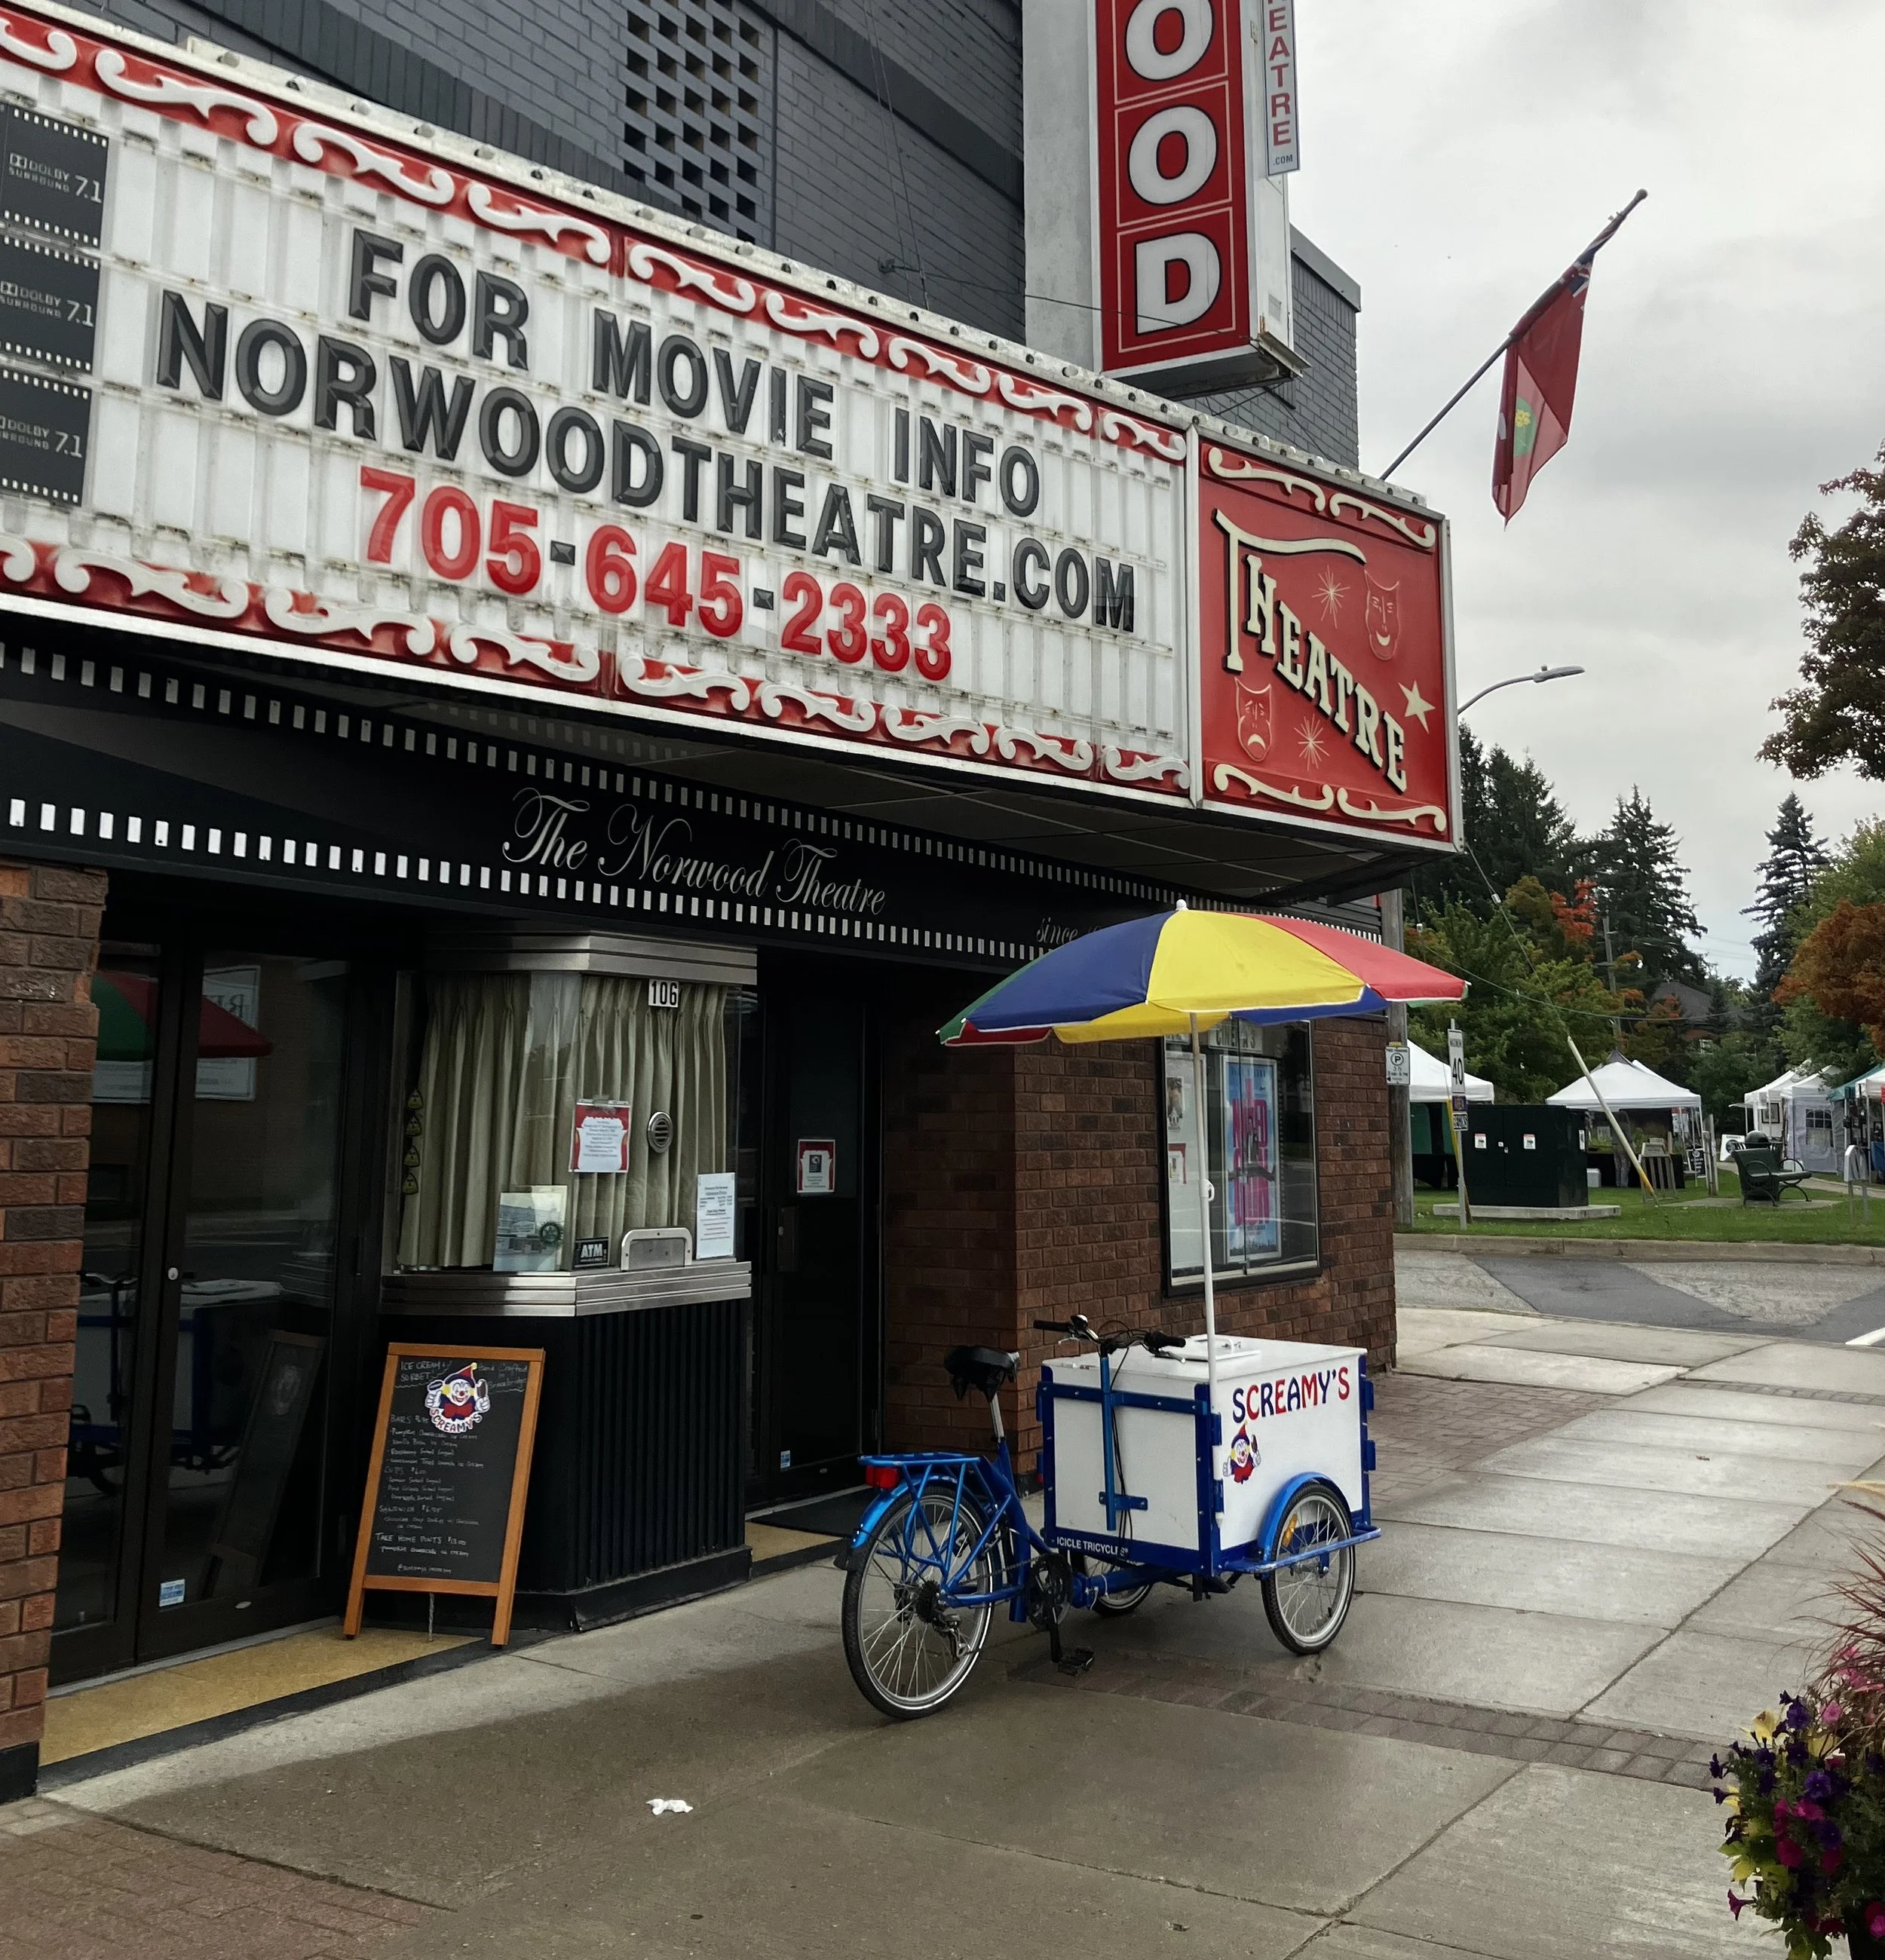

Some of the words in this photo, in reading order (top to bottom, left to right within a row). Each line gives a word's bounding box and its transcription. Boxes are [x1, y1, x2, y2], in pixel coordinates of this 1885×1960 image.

[1267, 0, 1292, 146] EATRE
[8, 166, 70, 193] SURROUND
[29, 159, 70, 182] DOLBY
[75, 174, 103, 204] 7.1
[20, 286, 61, 307] DOLBY
[66, 299, 94, 327] 7.1
[348, 228, 529, 371] FOR
[593, 306, 834, 461] MOVIE
[893, 406, 1039, 517] INFO
[8, 418, 50, 438] DOLBY
[54, 430, 83, 458] 7.1
[156, 289, 1134, 633] NORWOODTHEATRE.COM
[360, 465, 952, 681] 705-645-2333
[1211, 508, 1408, 794] THEATRE
[501, 787, 590, 870] The
[597, 803, 776, 898] Norwood
[775, 838, 887, 915] Theatre
[650, 981, 678, 1006] 106
[1452, 1057, 1464, 1086] 40
[580, 1243, 603, 1258] ATM
[400, 1361, 415, 1370] ICE
[1232, 1366, 1350, 1424] SCREAMY'S
[429, 1407, 483, 1432] SCREAMY'S
[1056, 1536, 1081, 1549] ICICLE
